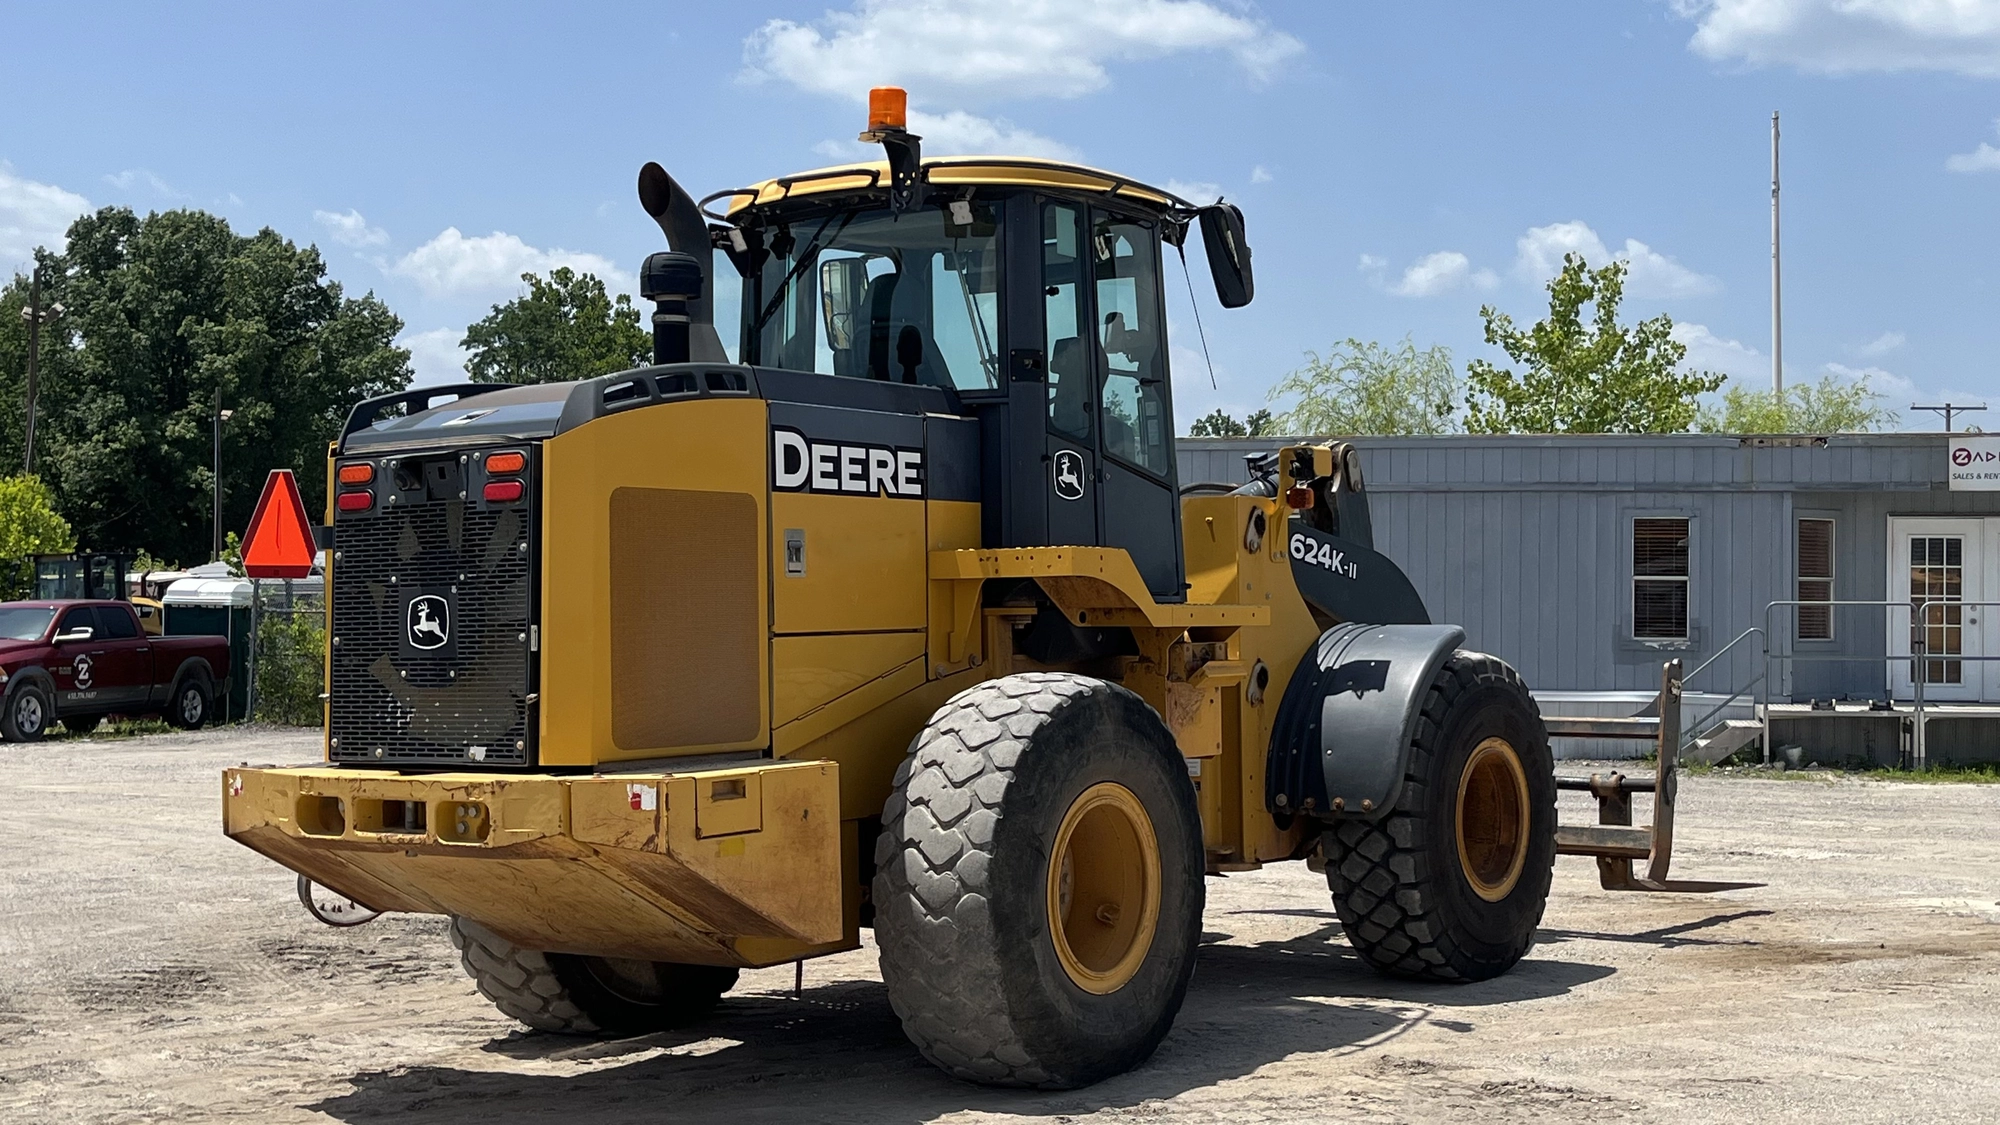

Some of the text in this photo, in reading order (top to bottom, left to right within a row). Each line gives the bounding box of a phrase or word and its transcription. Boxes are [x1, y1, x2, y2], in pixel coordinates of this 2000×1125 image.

[774, 430, 922, 495] DEERE
[1952, 472, 1974, 480] SALES
[1976, 472, 1982, 480] &
[78, 663, 89, 680] Z
